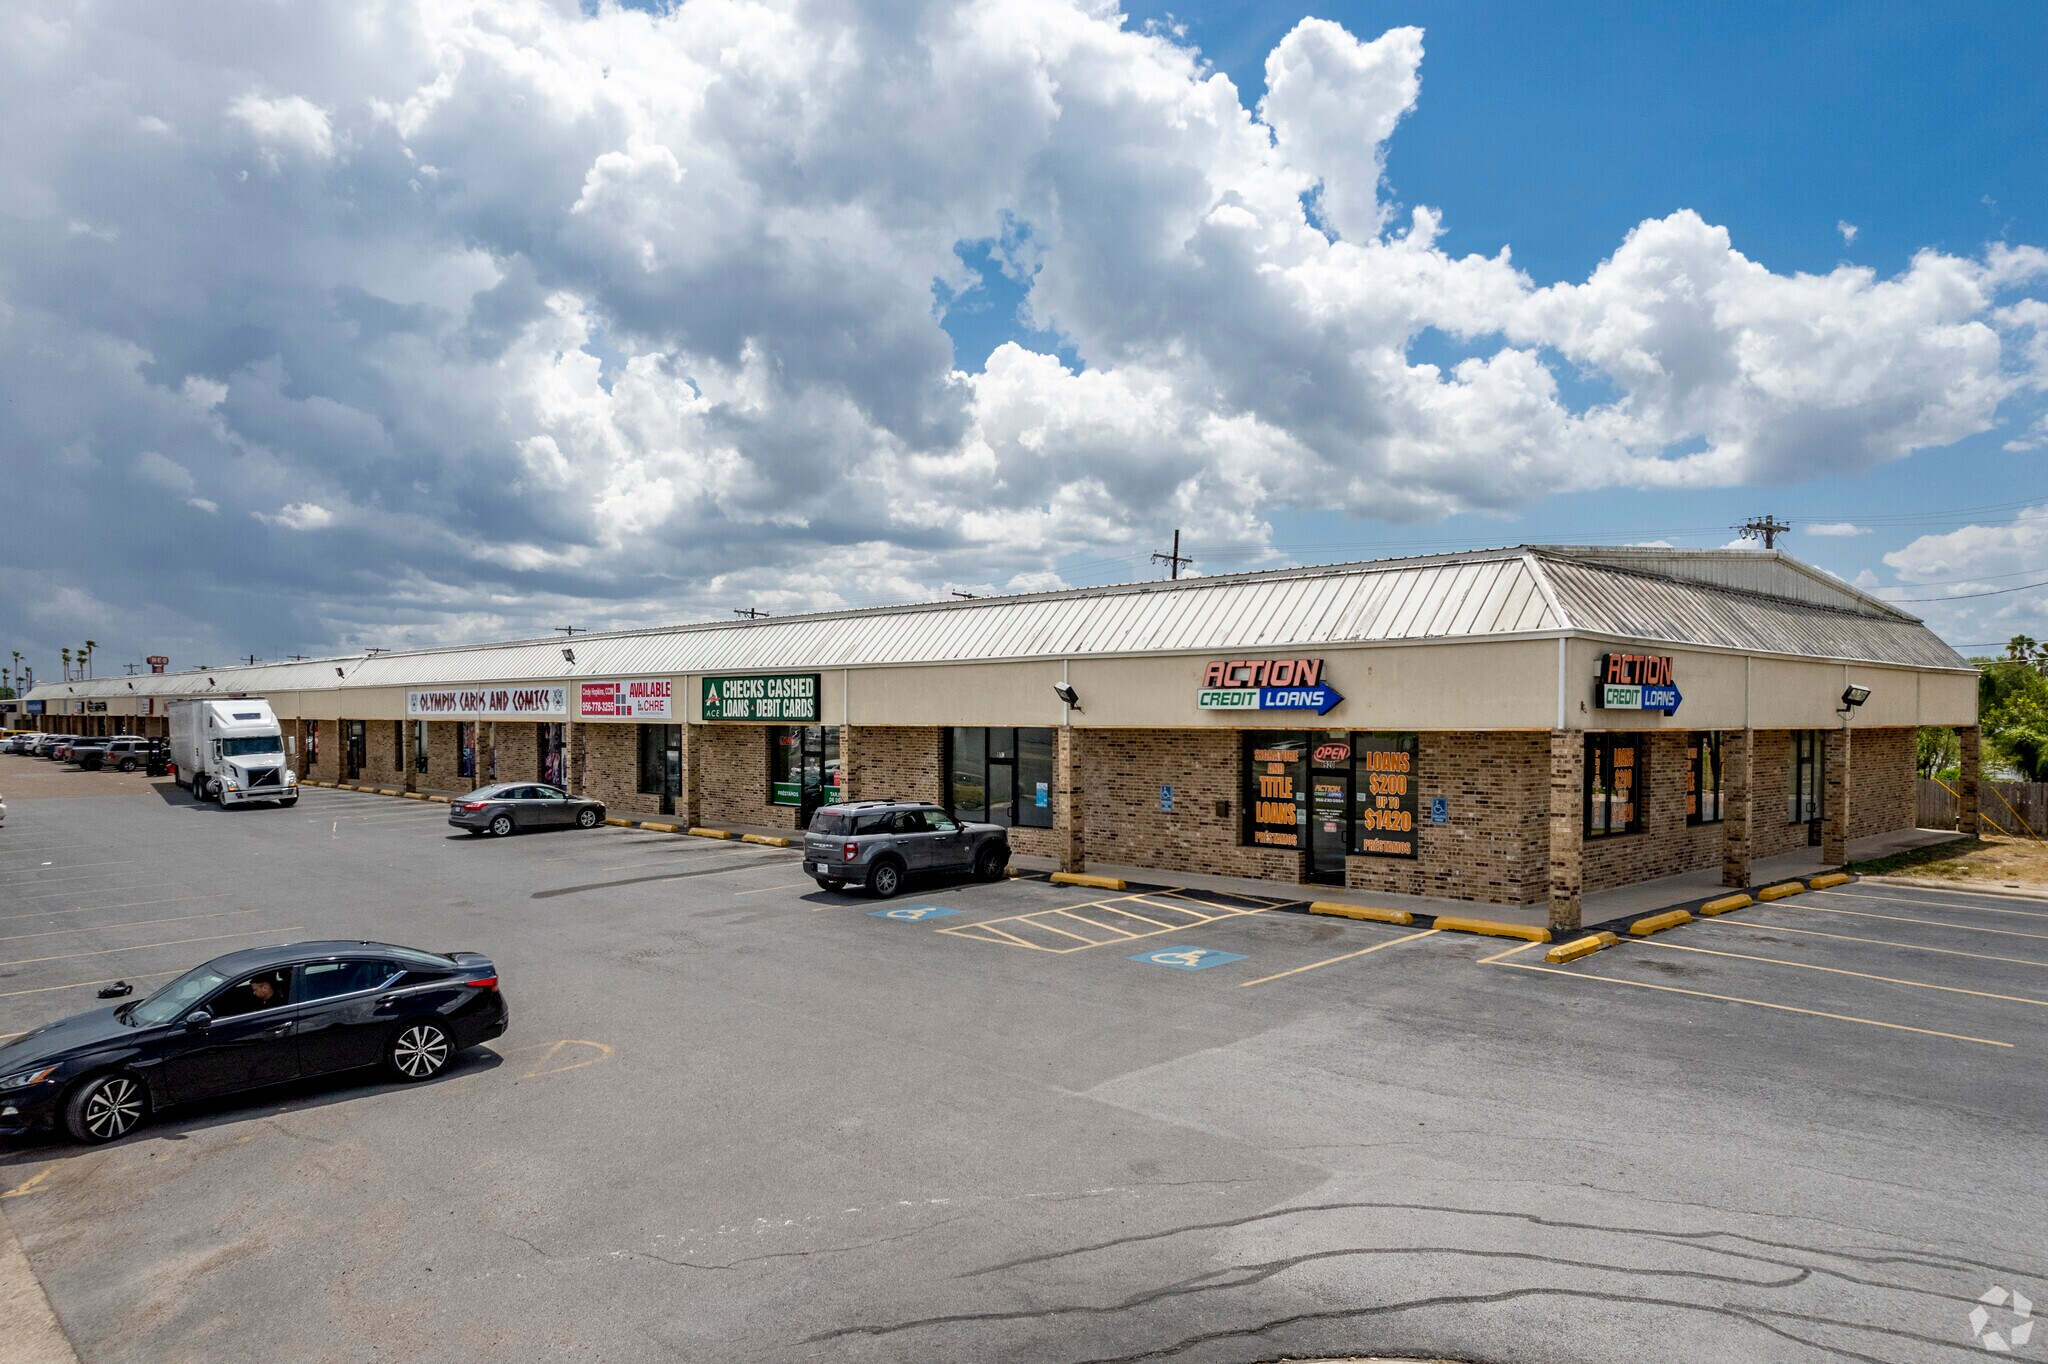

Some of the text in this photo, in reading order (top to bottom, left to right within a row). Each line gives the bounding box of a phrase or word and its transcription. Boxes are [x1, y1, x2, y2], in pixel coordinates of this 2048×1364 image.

[1202, 658, 1321, 687] ACTION
[1607, 653, 1673, 685] ACTION
[629, 681, 671, 698] AVAILABLE
[722, 678, 814, 698] CHECKS CASHED
[1606, 688, 1675, 706] CREDIT LOANS
[420, 691, 457, 712] OLYMPUS
[489, 690, 509, 711] AND
[512, 689, 549, 711] COMICS
[644, 700, 664, 712] CHRE
[722, 698, 813, 718] LOANS DEBIT CARDS
[1200, 691, 1325, 706] CREDIT LOANS
[706, 709, 720, 717] ACE
[1254, 749, 1299, 762] SIGNATURE
[1316, 746, 1348, 760] OPEN
[1366, 751, 1410, 772] LOANS
[1267, 762, 1285, 774] AND
[1259, 776, 1293, 798] TITLE
[1369, 772, 1407, 796] $200
[1375, 796, 1388, 808] UP
[1388, 796, 1400, 809] TO
[1255, 801, 1297, 825] LOANS
[1364, 808, 1412, 832] $1420
